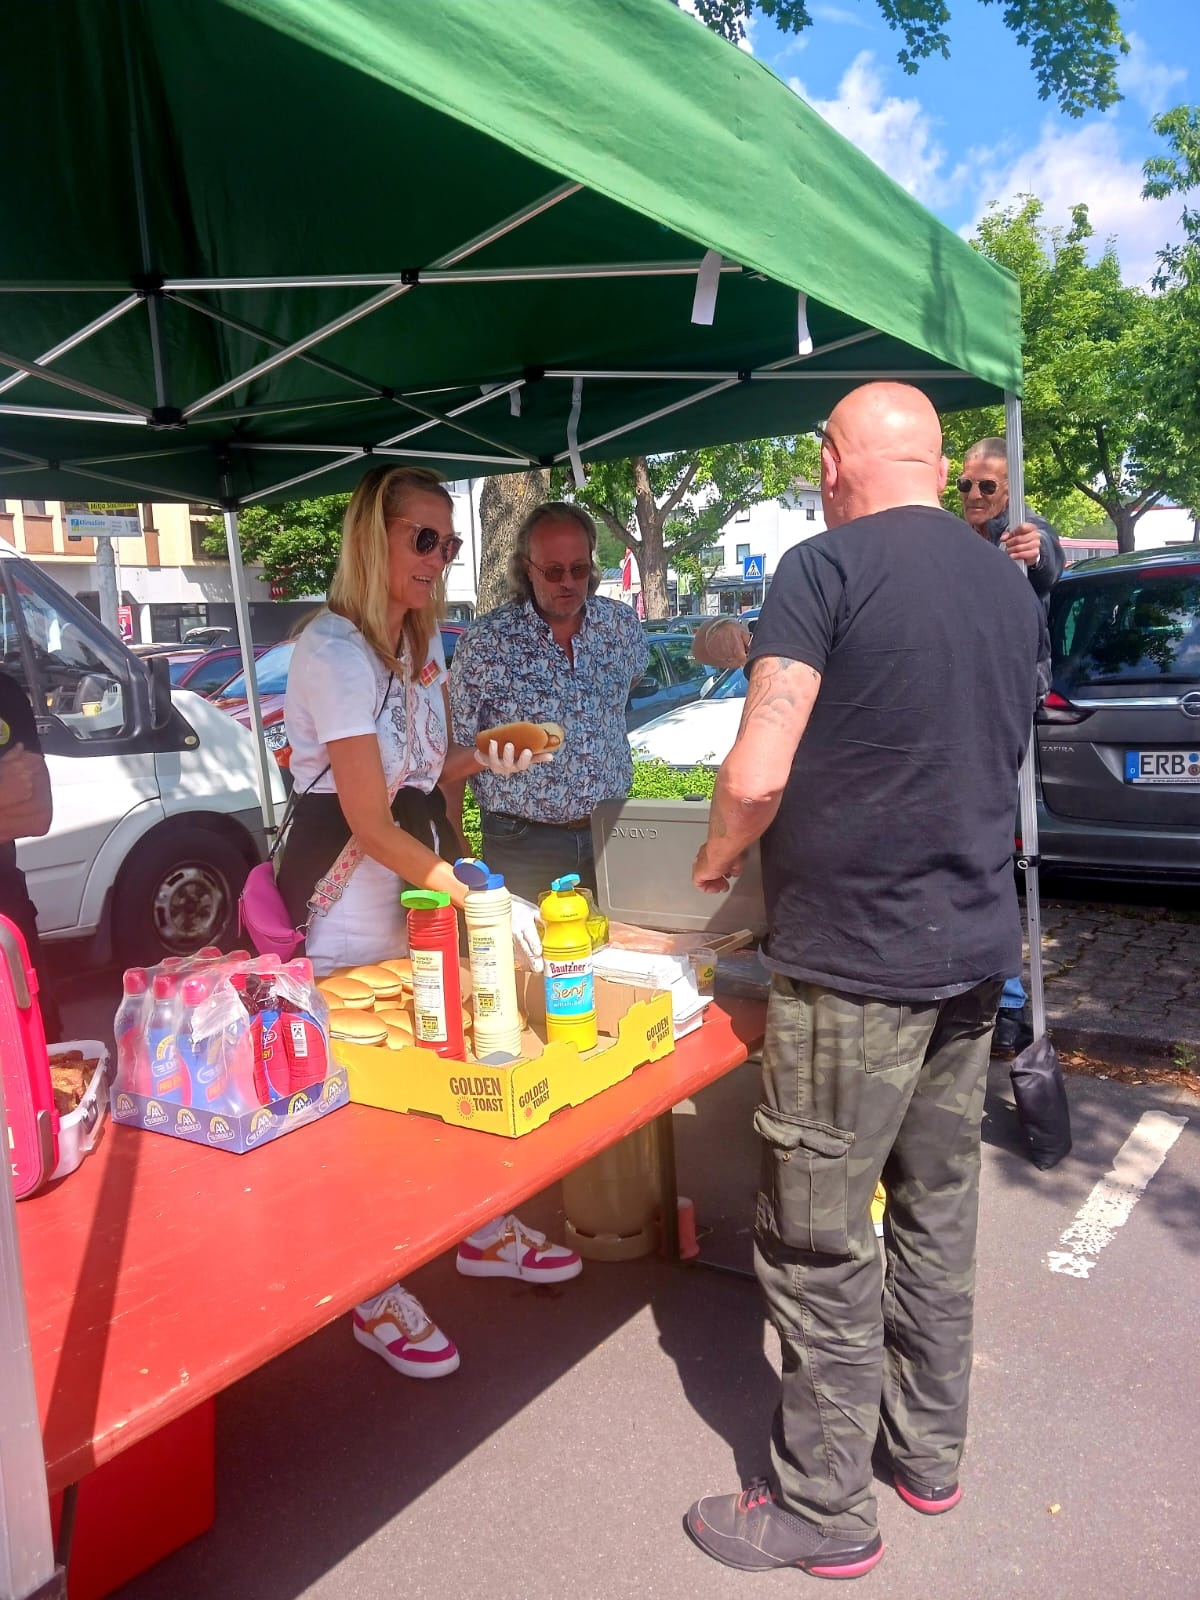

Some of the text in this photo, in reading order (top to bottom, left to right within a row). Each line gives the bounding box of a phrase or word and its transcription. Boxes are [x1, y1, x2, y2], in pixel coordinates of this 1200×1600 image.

[1140, 754, 1186, 775] ERB
[551, 978, 587, 1000] Senf
[646, 1015, 669, 1041] GOLDEN
[656, 1026, 670, 1043] TOAST
[449, 1077, 502, 1096] GOLDEN
[518, 1077, 549, 1108] GOLDEN
[472, 1097, 503, 1112] TOAST
[531, 1090, 550, 1109] TOAST
[182, 1115, 193, 1126] AA
[215, 1123, 227, 1134] AA
